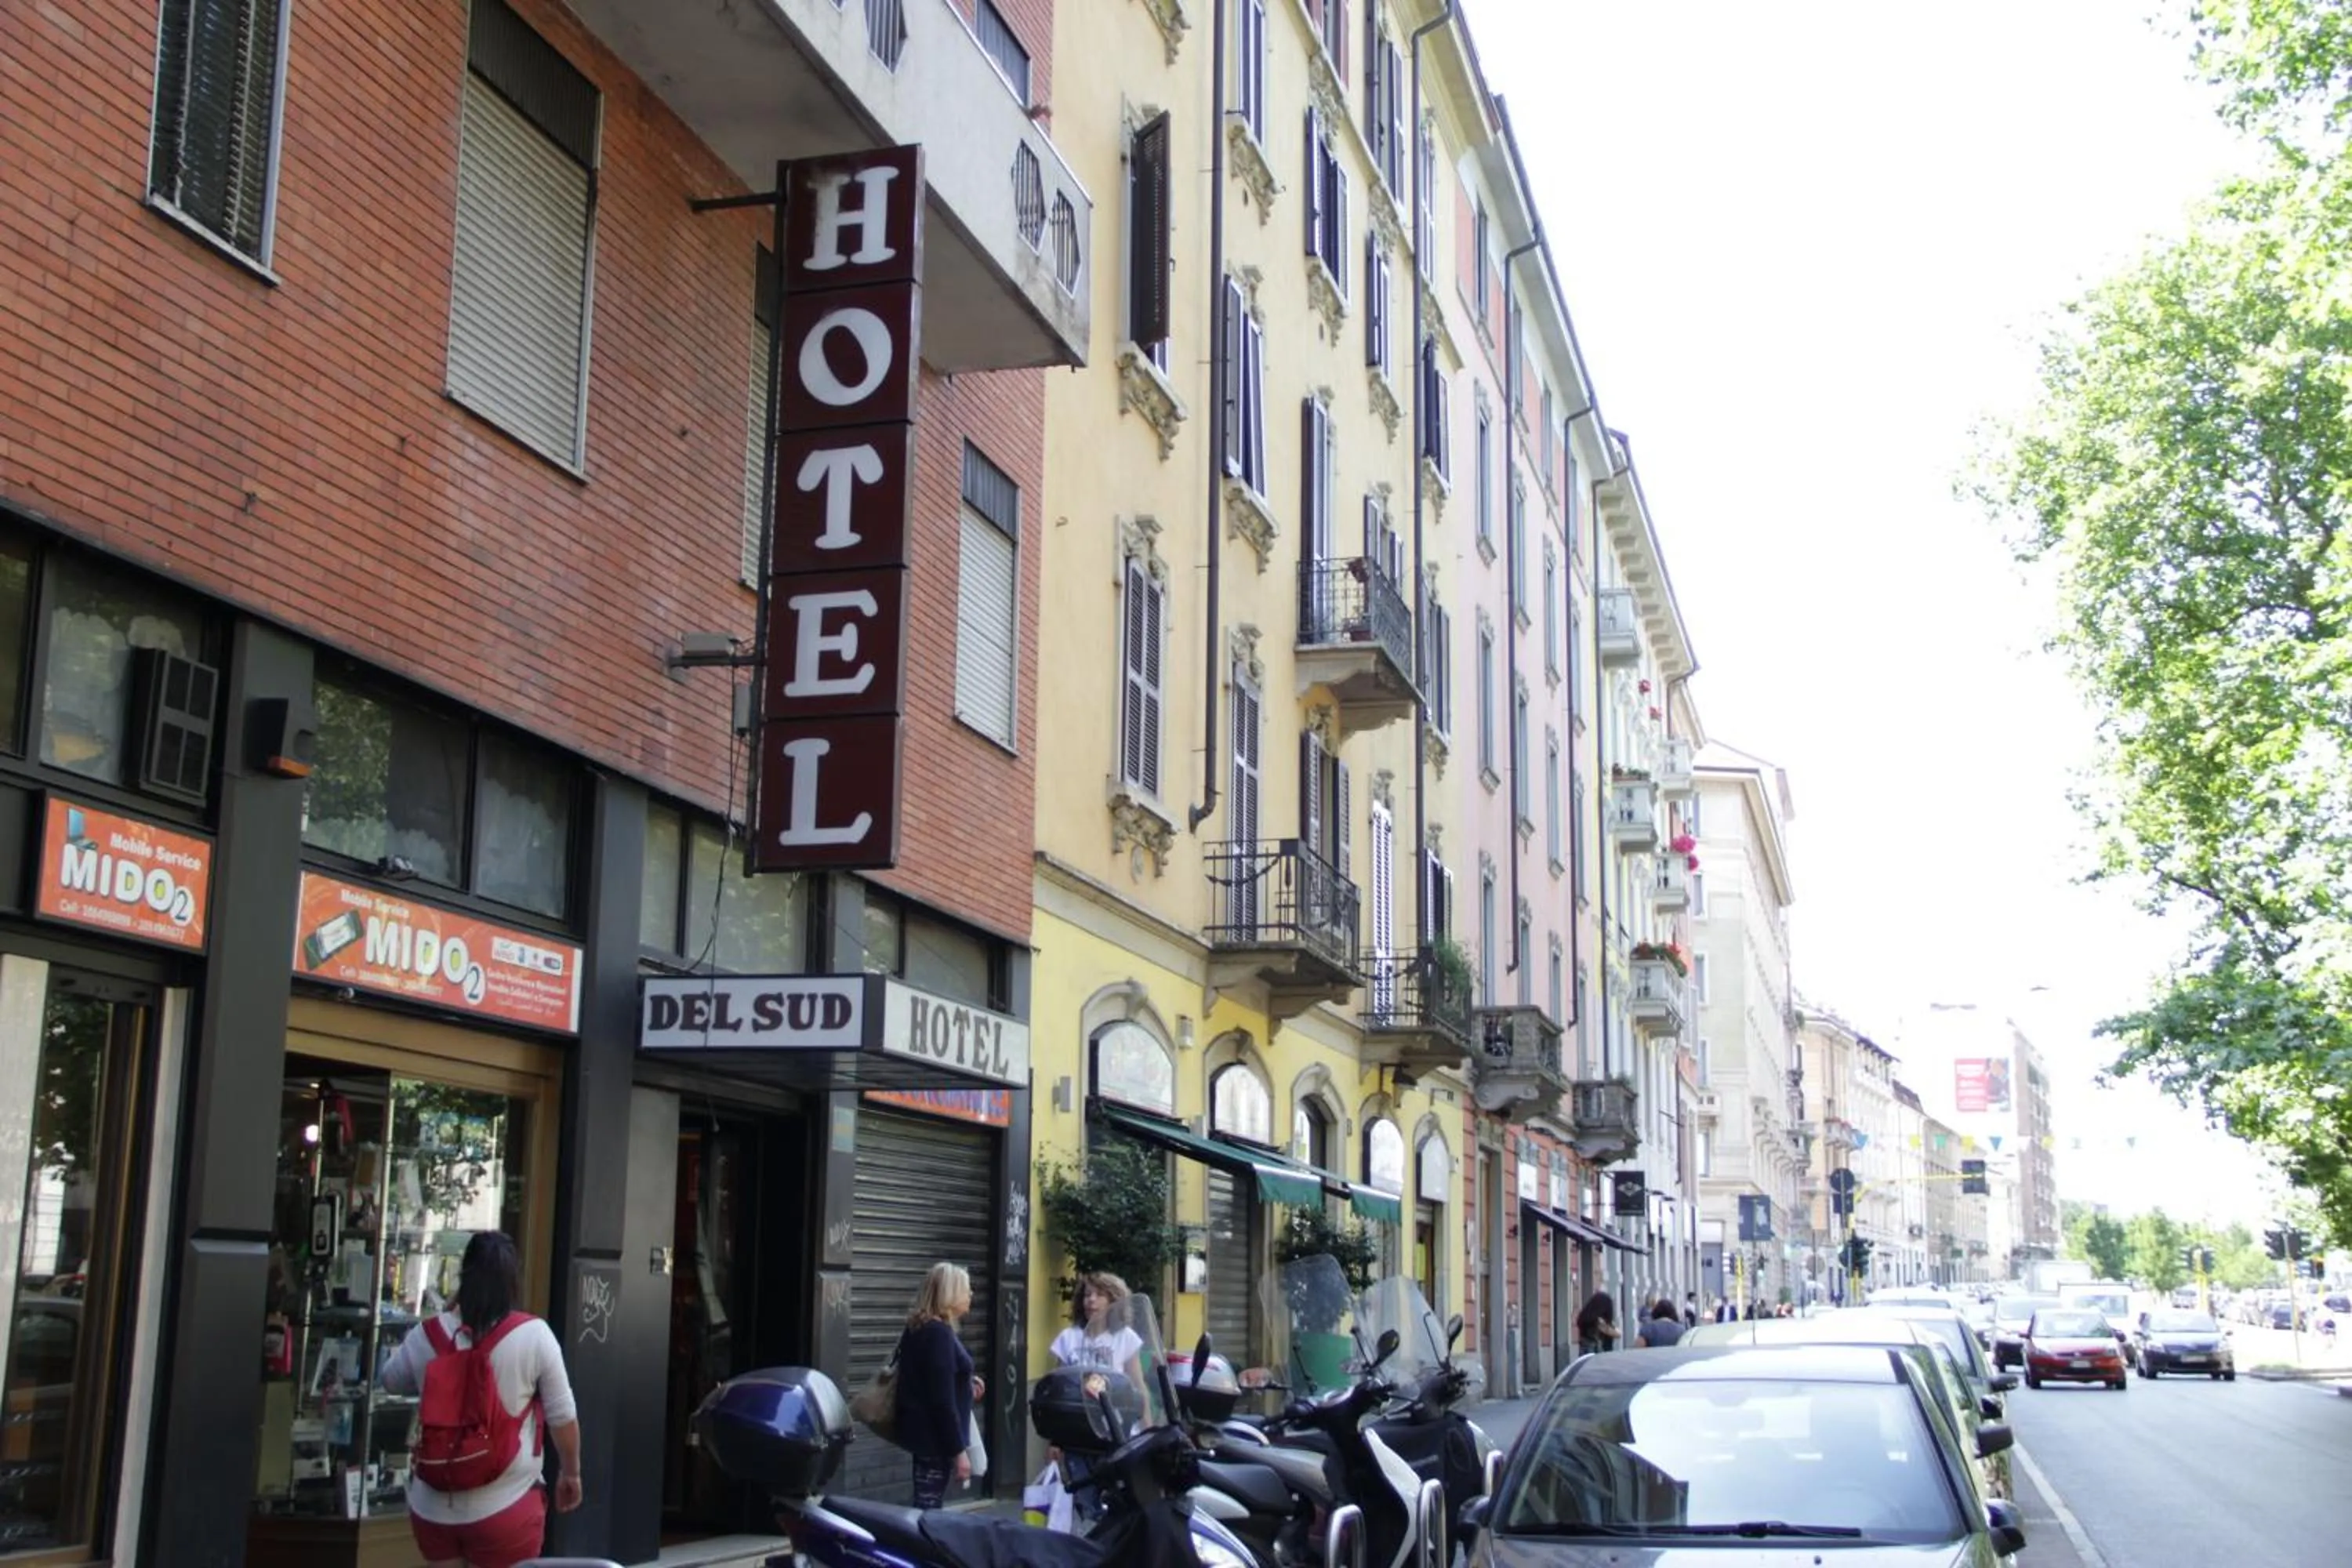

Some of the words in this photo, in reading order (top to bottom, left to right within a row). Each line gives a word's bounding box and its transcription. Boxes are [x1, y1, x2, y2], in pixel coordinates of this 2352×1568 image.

[779, 165, 900, 847] HOTEL
[110, 832, 153, 858] Mobile
[156, 846, 202, 871] Service
[648, 993, 742, 1033] DEL
[752, 992, 853, 1033] SUD
[909, 995, 1009, 1080] HOTEL
